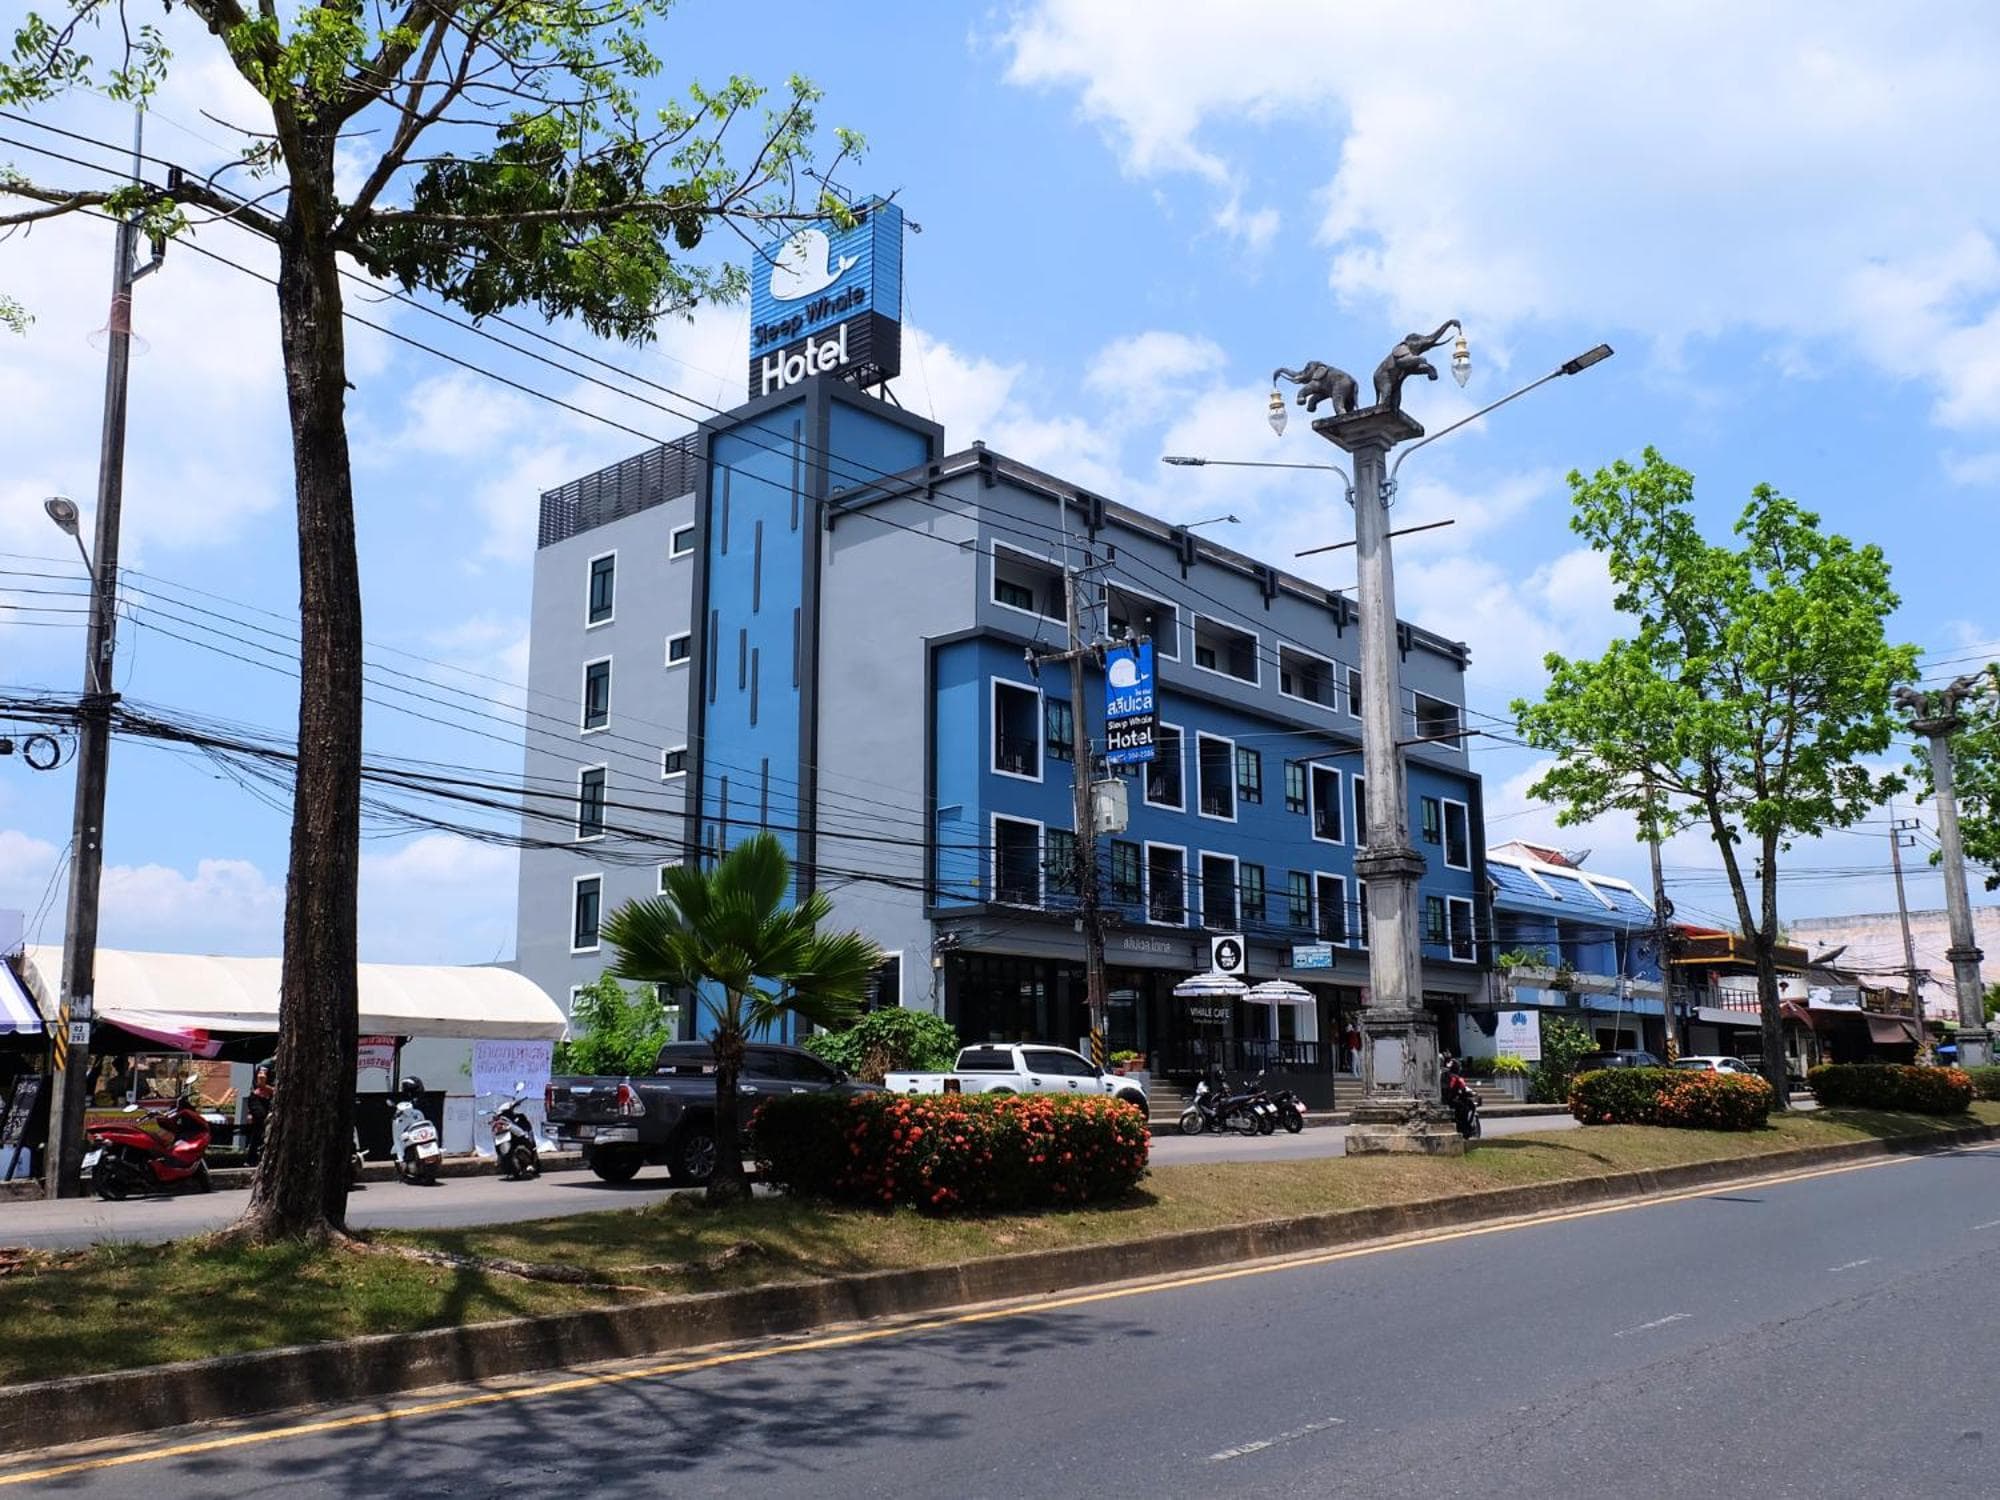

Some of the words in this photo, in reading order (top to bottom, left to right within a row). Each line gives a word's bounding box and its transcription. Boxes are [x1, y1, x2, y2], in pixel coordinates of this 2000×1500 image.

[754, 314, 803, 348] Sleep
[805, 285, 865, 324] Whale
[761, 322, 849, 396] Hotel
[1108, 726, 1153, 750] Hotel
